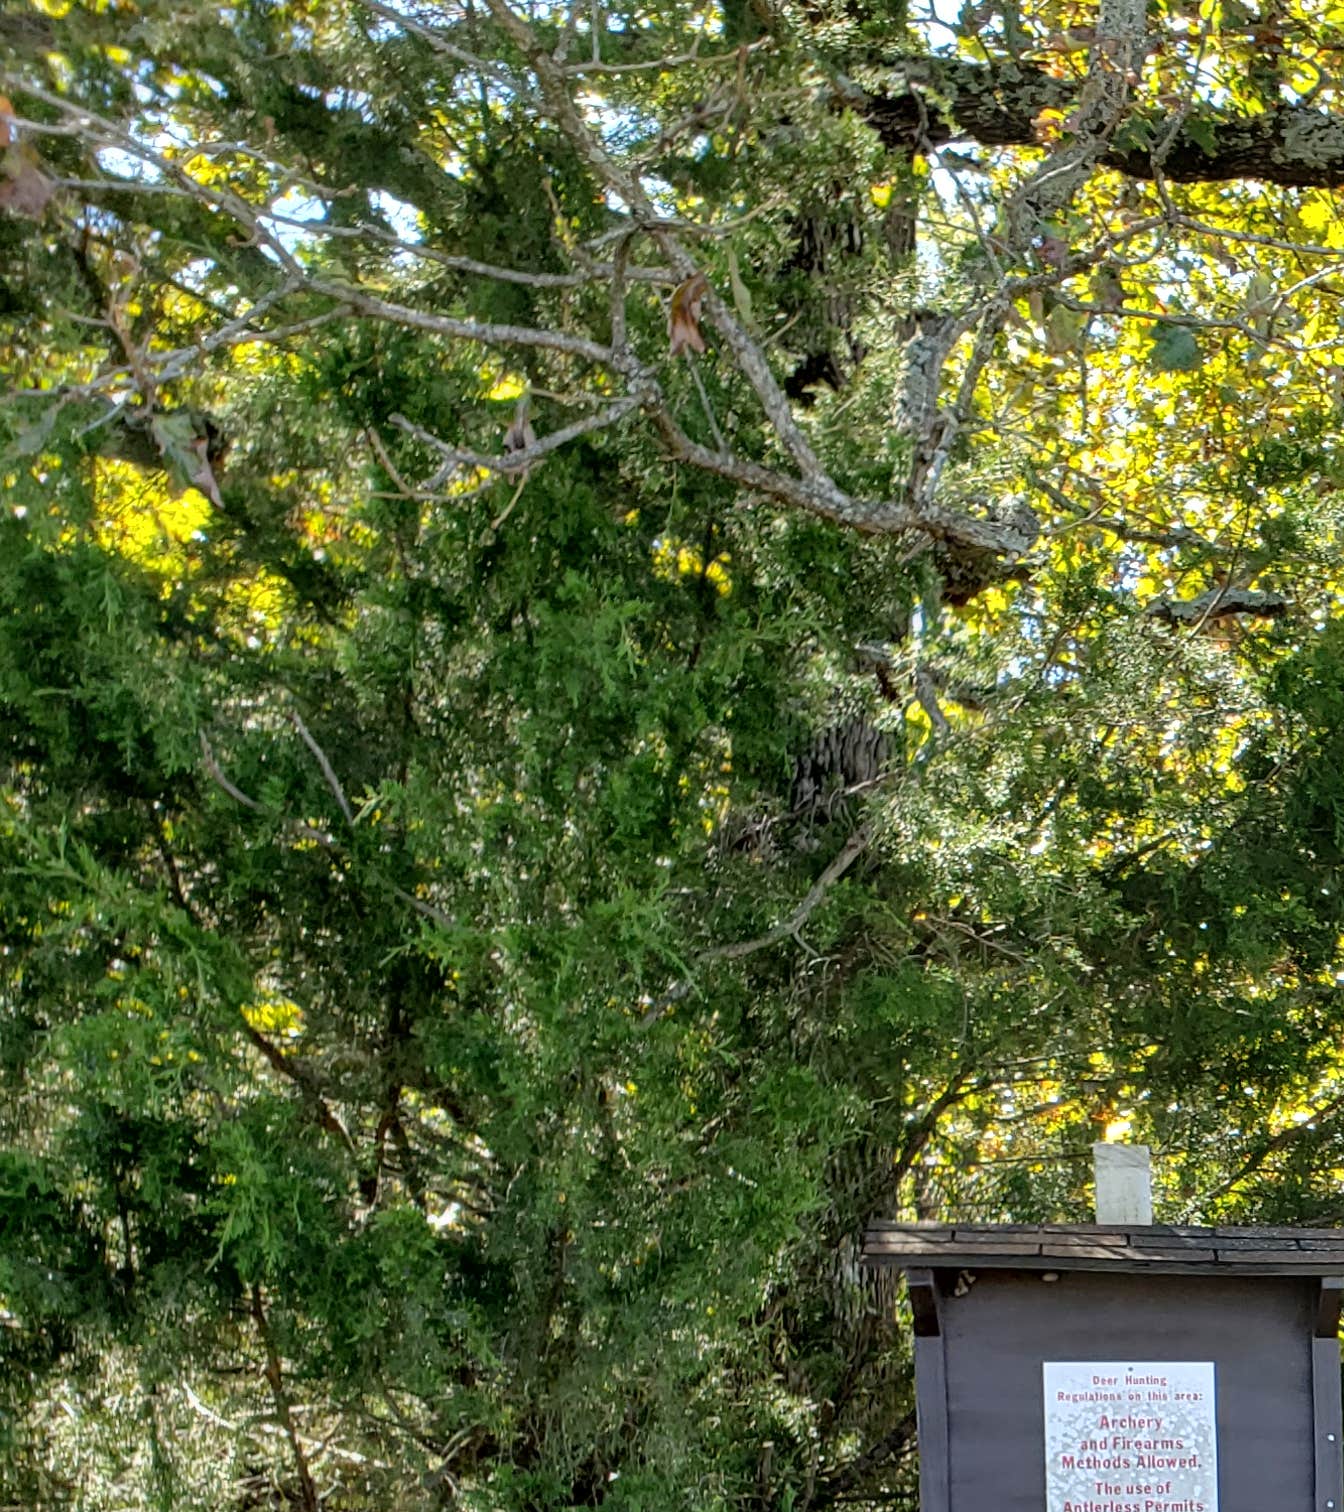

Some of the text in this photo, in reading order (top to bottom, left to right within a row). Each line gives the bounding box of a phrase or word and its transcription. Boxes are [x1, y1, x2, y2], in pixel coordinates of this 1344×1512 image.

[1093, 1375, 1167, 1386] Deer Hunting
[1057, 1391, 1202, 1402] Regulations on this area:
[1099, 1415, 1163, 1431] Archery
[1081, 1437, 1184, 1451] and Firearms
[1062, 1455, 1202, 1469] Methods Allowed.
[1096, 1482, 1171, 1495] The use of
[1145, 1499, 1204, 1512] Permits
